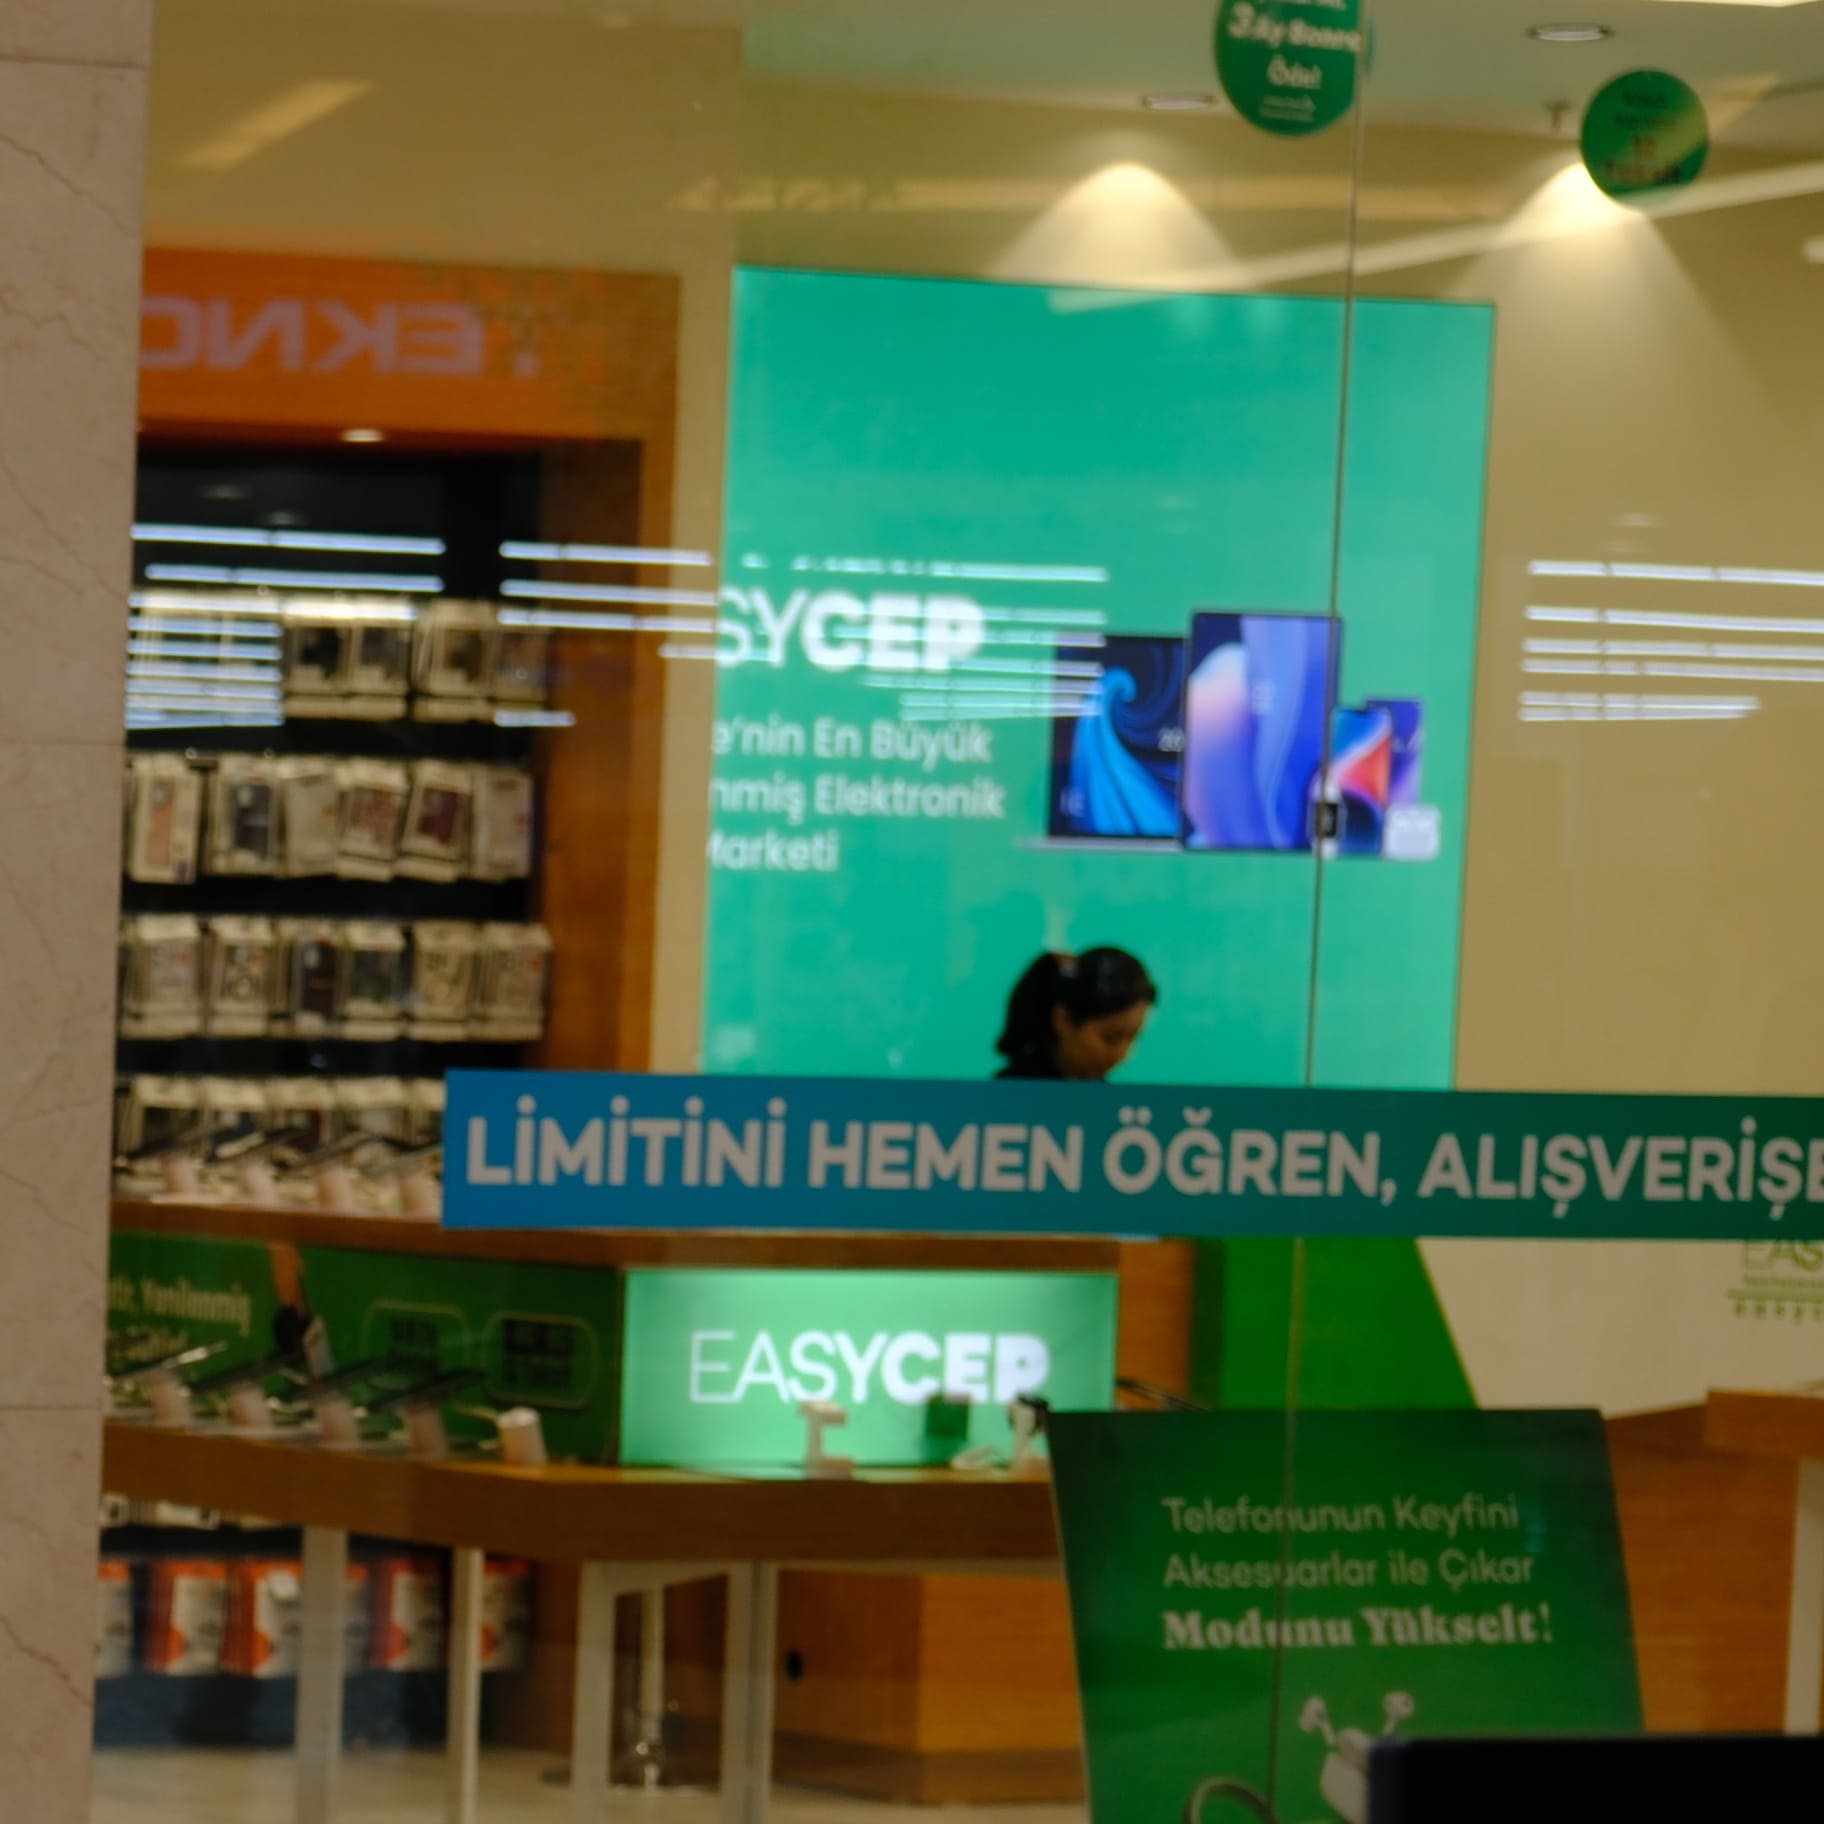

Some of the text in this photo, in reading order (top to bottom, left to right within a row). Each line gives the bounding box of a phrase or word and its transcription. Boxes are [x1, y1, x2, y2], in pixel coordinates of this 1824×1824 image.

[813, 716, 863, 760] En
[870, 716, 993, 770] Büyük
[813, 775, 1005, 821] Elektronik
[466, 1094, 788, 1188] LİMİTİNİ
[808, 1120, 1084, 1193] HEMEN
[1103, 1106, 1398, 1206] ÖĞREN,
[689, 1329, 1051, 1406] EASYCEP
[1162, 1493, 1519, 1539] Telefonunun Keyfini
[1163, 1547, 1534, 1592] Aksesuarlar ile Çıkar
[1162, 1602, 1553, 1651] Modunu Yükselt!
